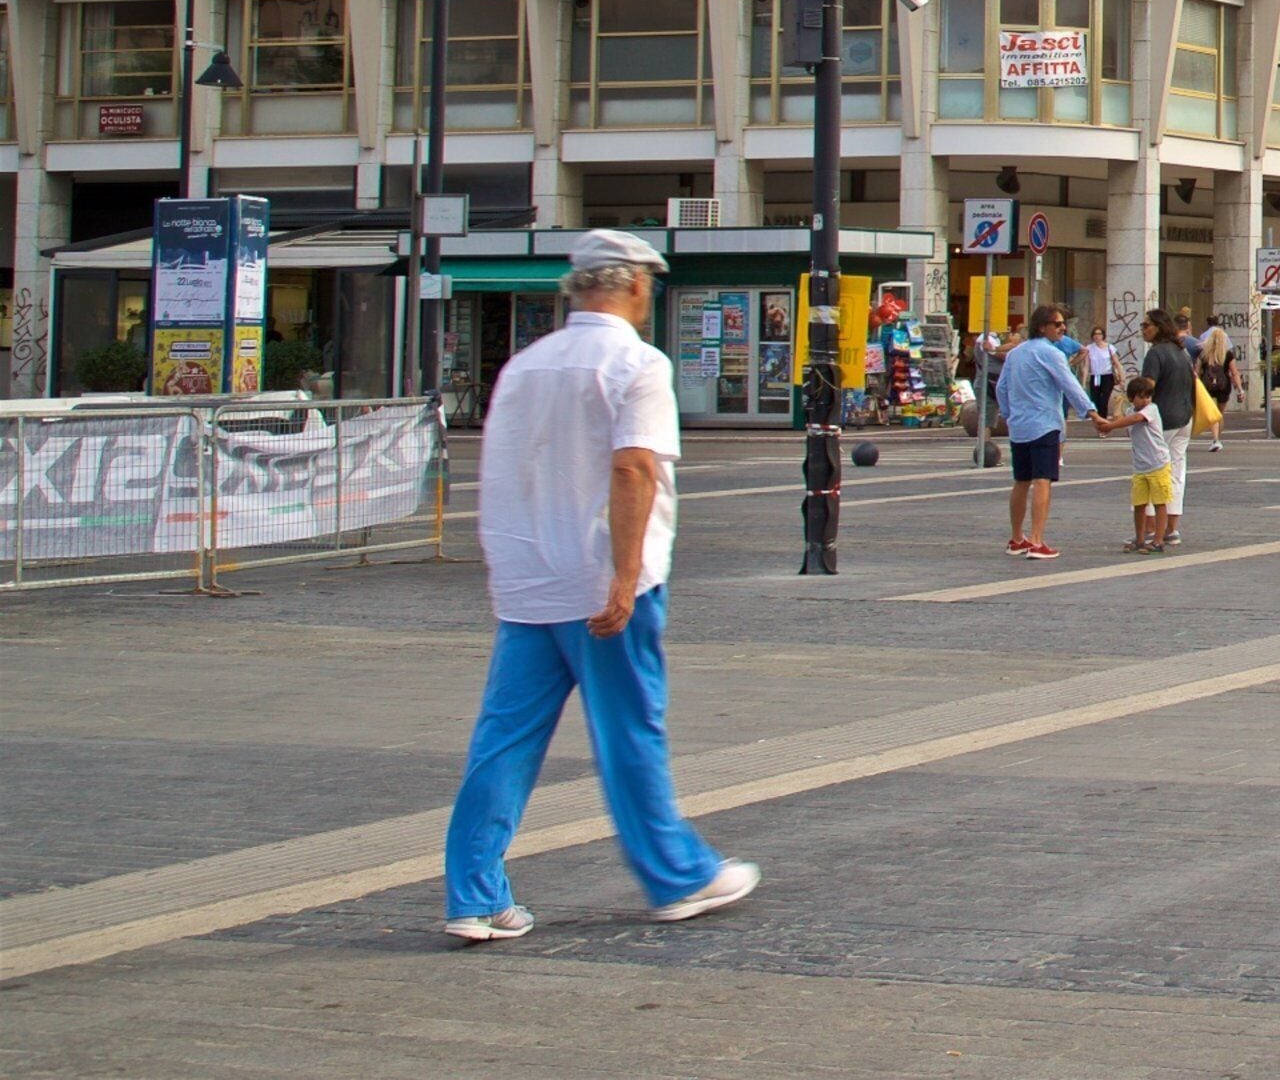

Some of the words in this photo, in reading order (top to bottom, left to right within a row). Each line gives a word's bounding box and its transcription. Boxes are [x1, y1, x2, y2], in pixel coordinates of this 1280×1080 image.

[1001, 32, 1082, 51] Jasci
[1001, 52, 1082, 60] immobiliare
[1007, 61, 1081, 76] AFFITTA
[101, 116, 141, 124] OCULISTA
